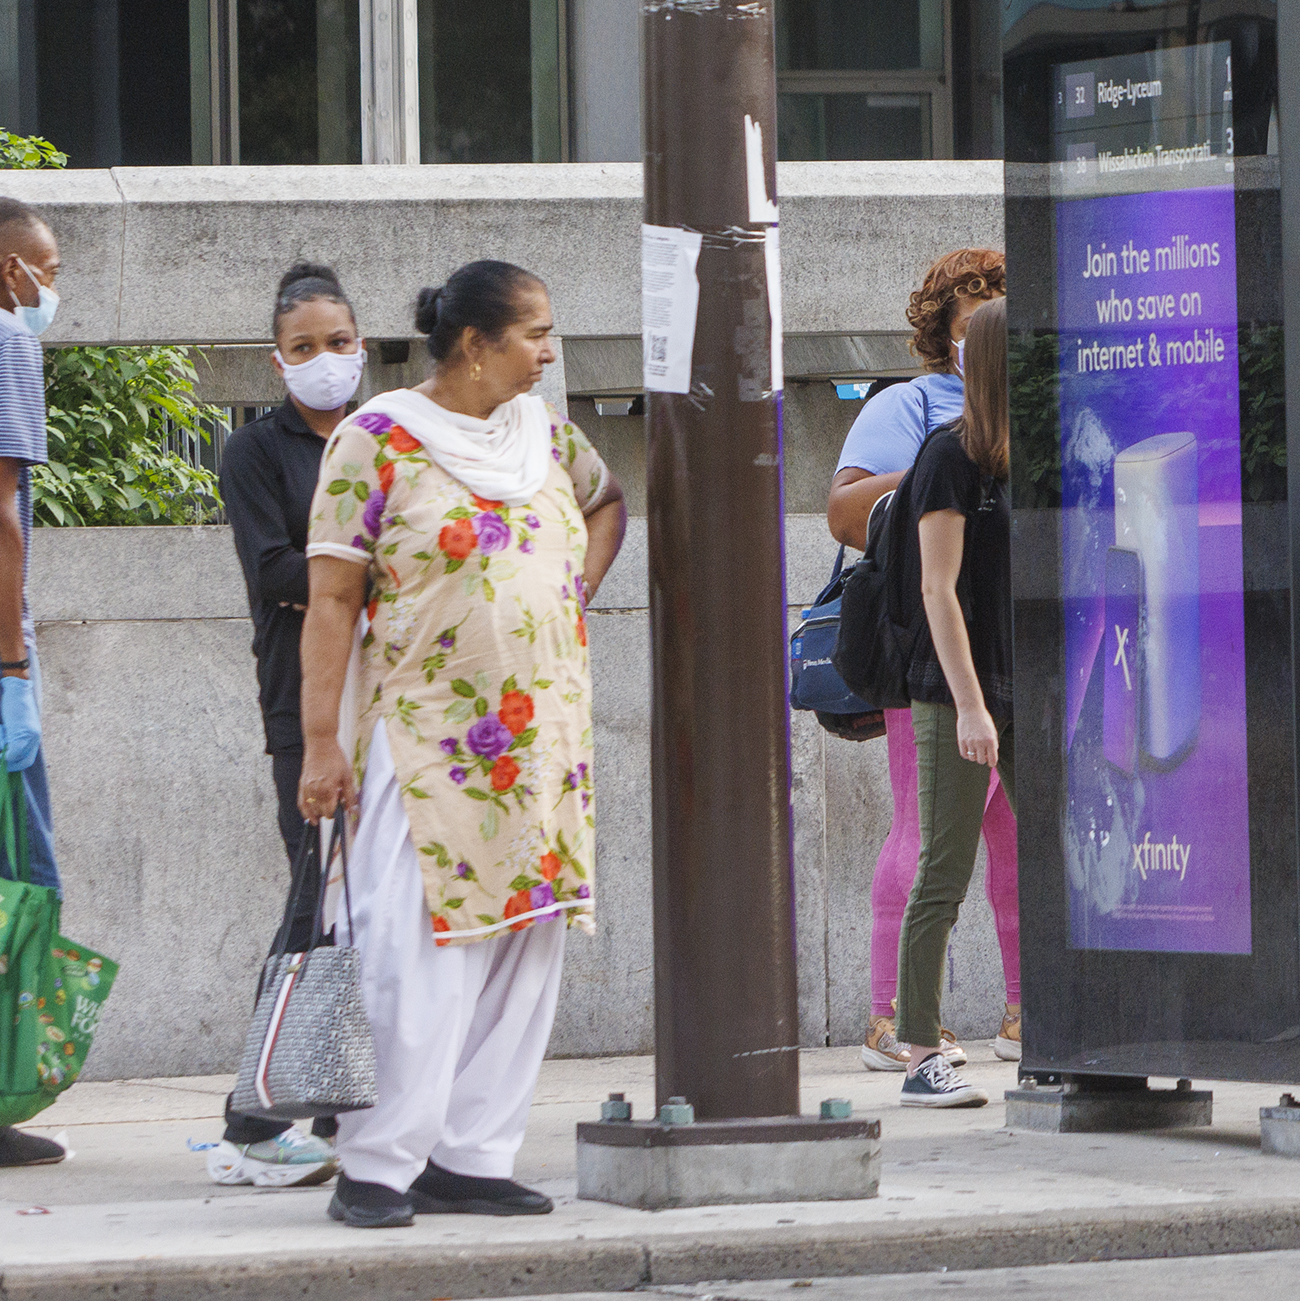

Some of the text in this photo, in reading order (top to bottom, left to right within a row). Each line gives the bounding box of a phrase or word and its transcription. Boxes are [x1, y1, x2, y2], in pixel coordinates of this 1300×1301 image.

[1075, 86, 1086, 104] 32
[1097, 79, 1163, 109] Ridge-Lyceum
[1083, 235, 1220, 279] Join the millions
[1096, 290, 1202, 324] who save on
[1077, 328, 1224, 373] internet & mobile
[1131, 831, 1190, 881] xfinity
